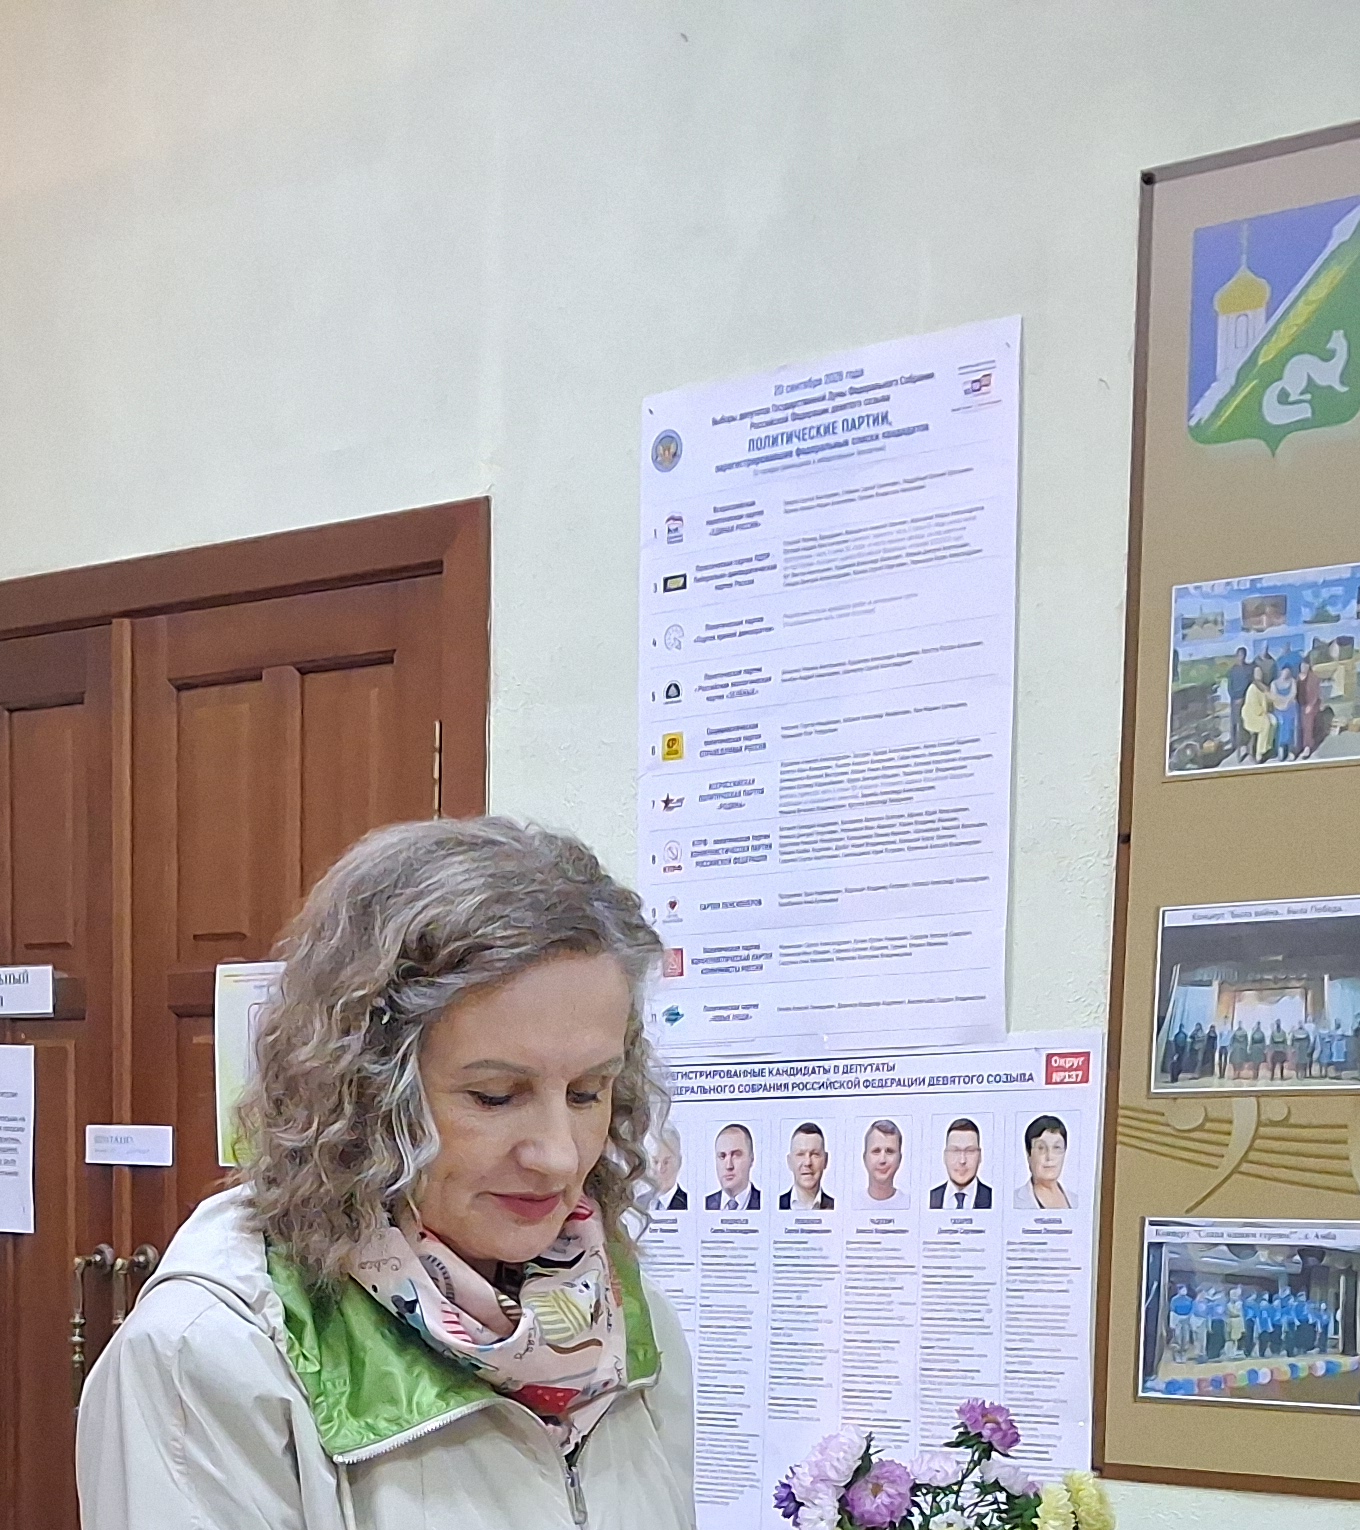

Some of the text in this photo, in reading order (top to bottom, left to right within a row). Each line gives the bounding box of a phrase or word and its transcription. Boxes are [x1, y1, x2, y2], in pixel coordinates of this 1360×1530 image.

[747, 420, 838, 452] ПОЛИТИЧЕСКИЕ
[767, 1065, 831, 1078] КАНДИДАТЫ
[842, 1062, 896, 1075] ДЕПУТАТЫ
[1051, 1056, 1085, 1068] Округ
[737, 1081, 790, 1094] СОБРАНИЯ
[791, 1077, 860, 1092] РОССИЙСКОЙ
[862, 1076, 926, 1089] ФЕДЕРАЦИИ
[927, 1075, 984, 1088] ДЕВЯТОГО
[986, 1073, 1035, 1085] СОЗЫВА
